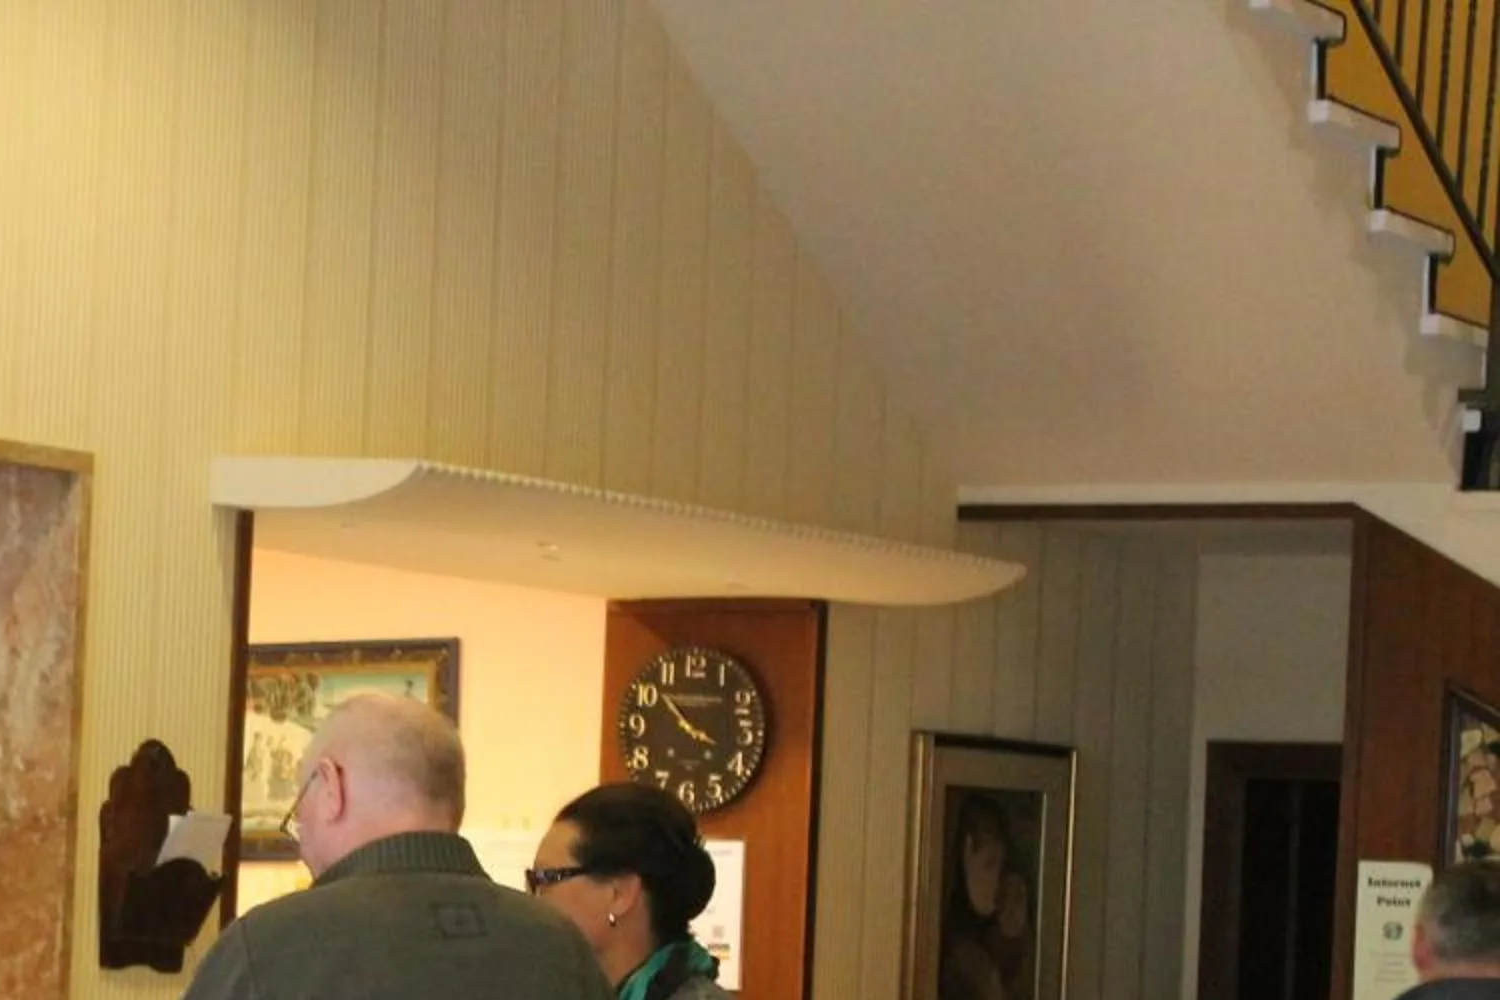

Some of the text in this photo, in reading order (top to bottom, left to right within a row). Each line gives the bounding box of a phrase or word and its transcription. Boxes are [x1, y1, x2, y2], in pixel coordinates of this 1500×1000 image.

[661, 662, 675, 685] 11
[685, 655, 706, 678] 12
[638, 684, 657, 707] 10
[735, 691, 751, 715] 2
[629, 714, 645, 738] 9
[737, 720, 752, 745] 3
[633, 746, 648, 769] 8
[728, 752, 743, 776] 4
[656, 770, 669, 789] 7
[707, 774, 722, 799] 5
[678, 781, 694, 803] 6
[1367, 877, 1421, 889] Internet
[1376, 896, 1411, 908] Point
